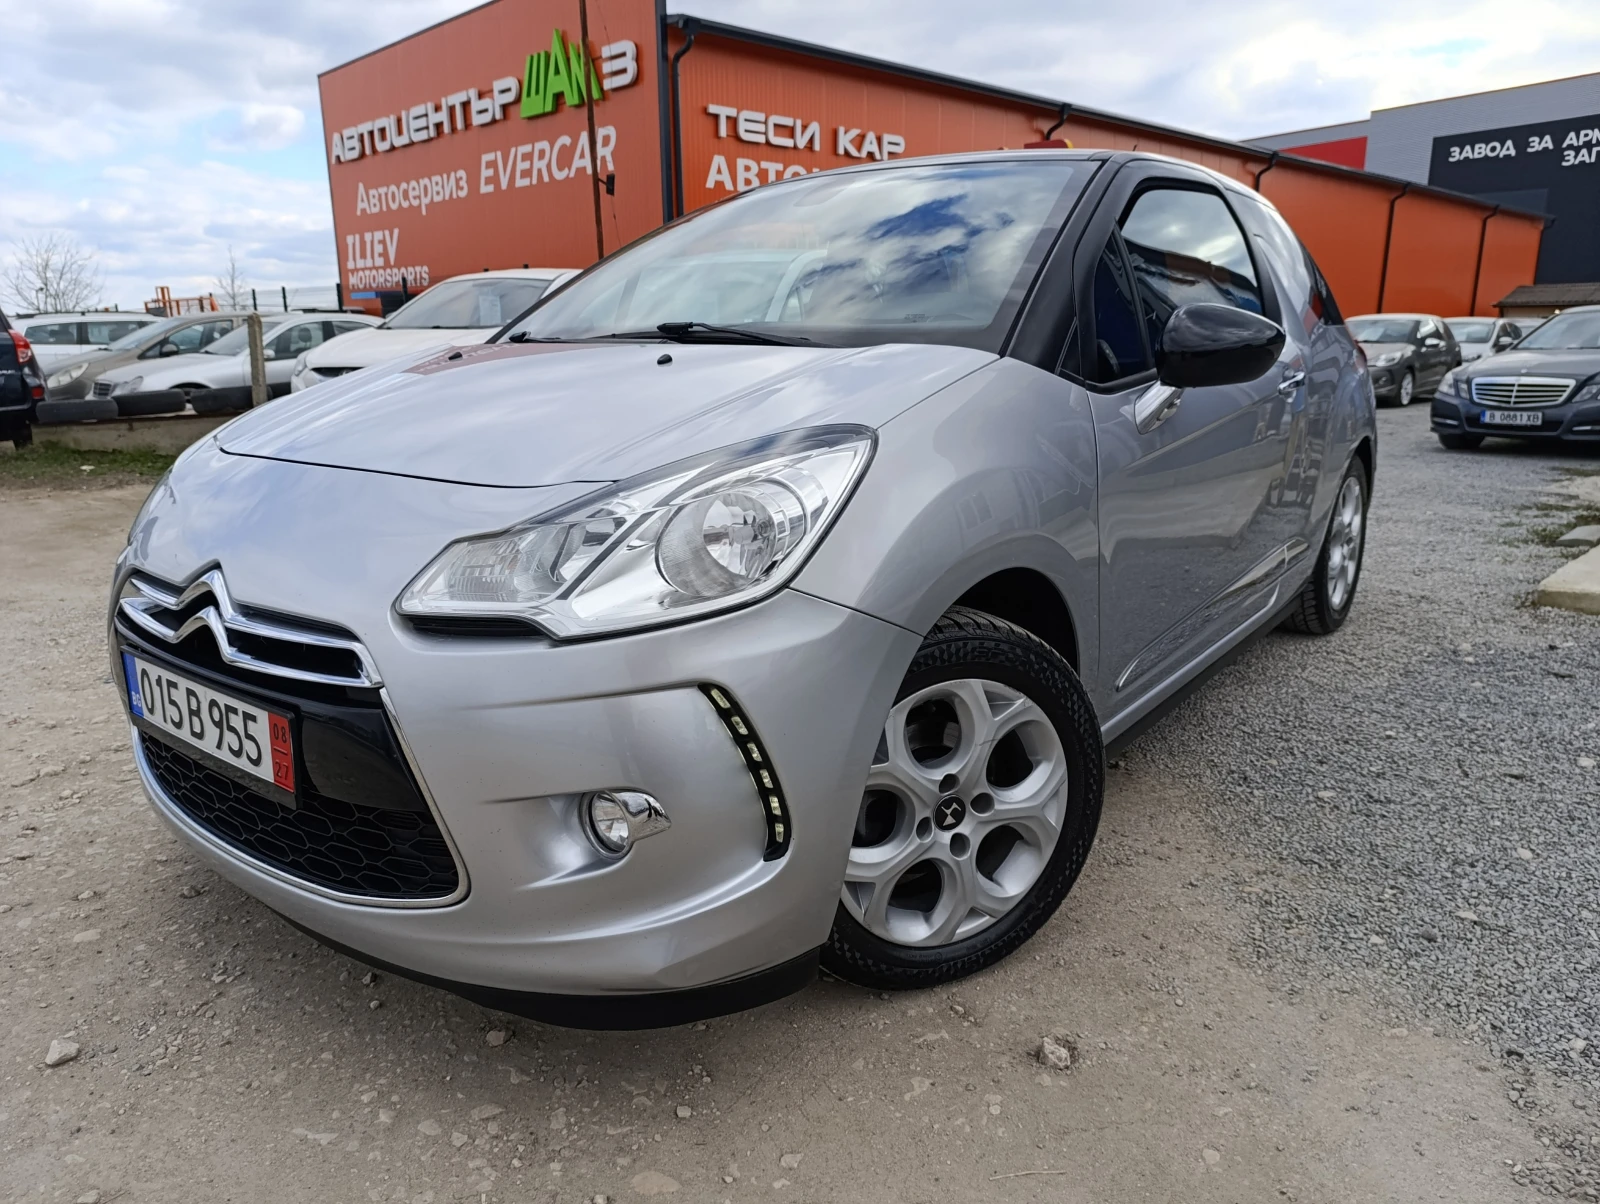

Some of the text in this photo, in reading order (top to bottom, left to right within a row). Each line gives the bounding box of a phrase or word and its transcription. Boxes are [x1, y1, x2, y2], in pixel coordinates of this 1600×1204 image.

[331, 76, 520, 164] АВТОЦЕНТЪР
[706, 103, 905, 161] ТЕСИ КАР
[1448, 139, 1516, 162] ЗАВОД
[1527, 134, 1554, 152] ЗА
[356, 125, 617, 216] Автосервиз EVERCAR
[706, 155, 820, 192] АВТ
[346, 228, 400, 270] ILIEV
[348, 265, 430, 290] MOTORSPORTS
[273, 723, 288, 744] 08
[275, 760, 289, 781] 27
